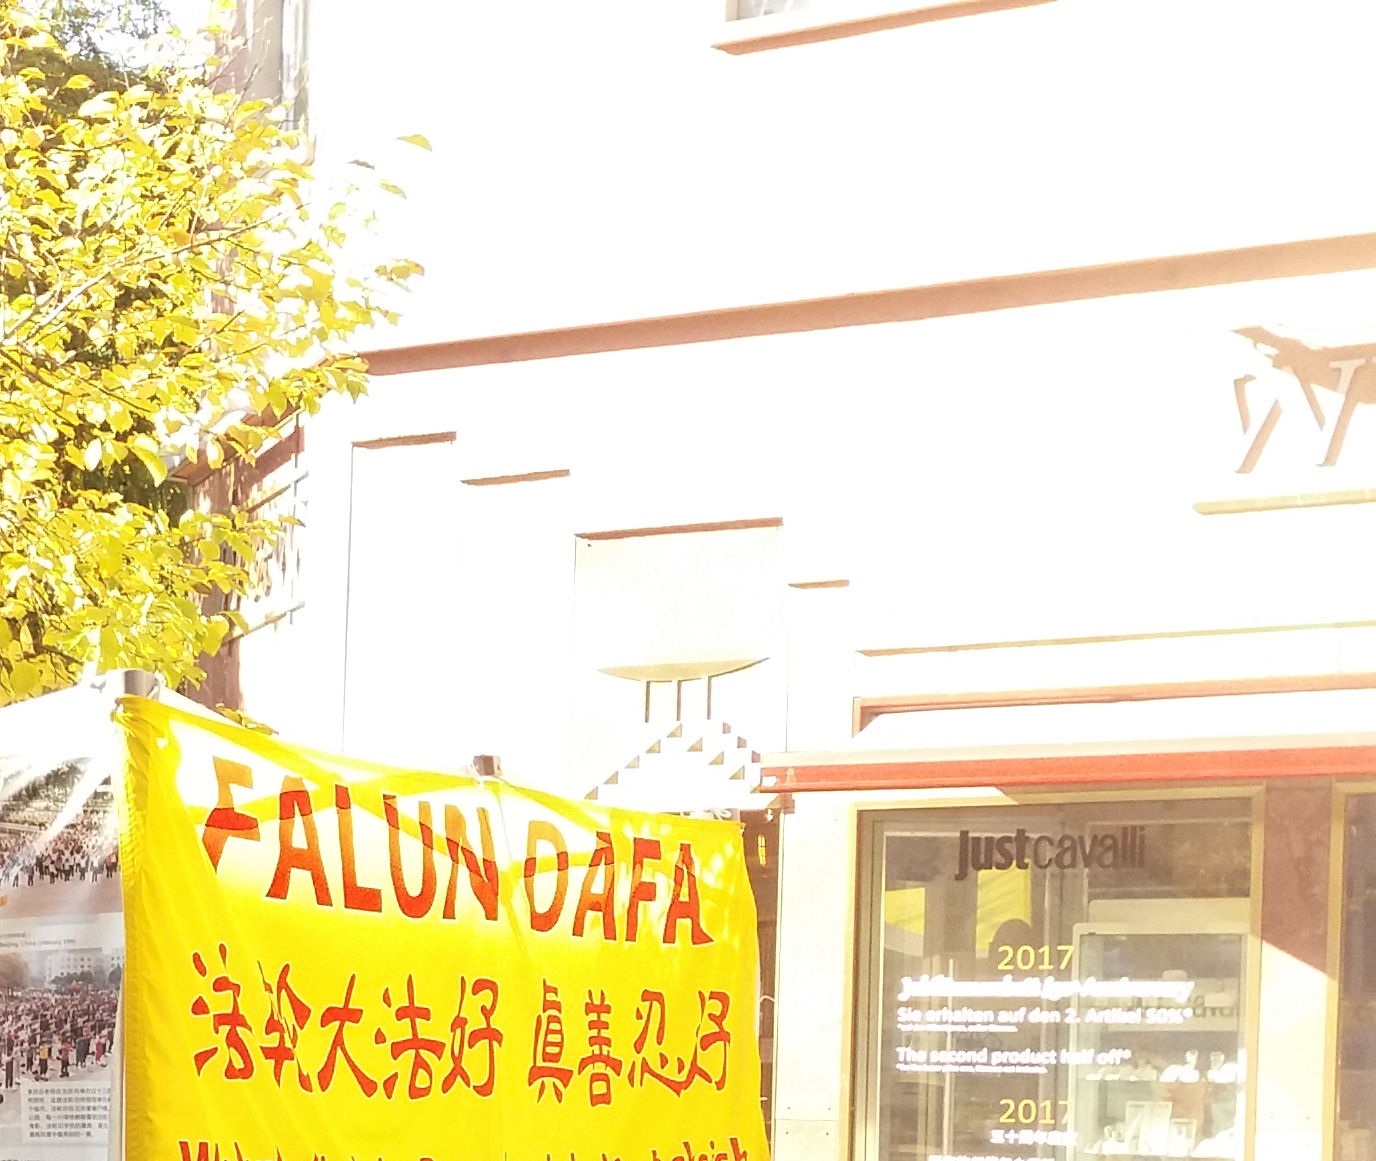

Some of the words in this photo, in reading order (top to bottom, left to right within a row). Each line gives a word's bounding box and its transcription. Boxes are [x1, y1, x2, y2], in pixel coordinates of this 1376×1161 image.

[202, 755, 500, 922] FALUN
[522, 819, 715, 947] DAFA
[998, 945, 1074, 970] 2017
[898, 1006, 922, 1022] Sie
[925, 1007, 994, 1023] erhalten
[998, 1007, 1026, 1023] auf
[1028, 1007, 1061, 1023] den
[1064, 1008, 1081, 1023] 2.
[1085, 1008, 1141, 1024] Artikel
[897, 1048, 927, 1063] The
[930, 1049, 987, 1063] second
[991, 1050, 1057, 1067] product
